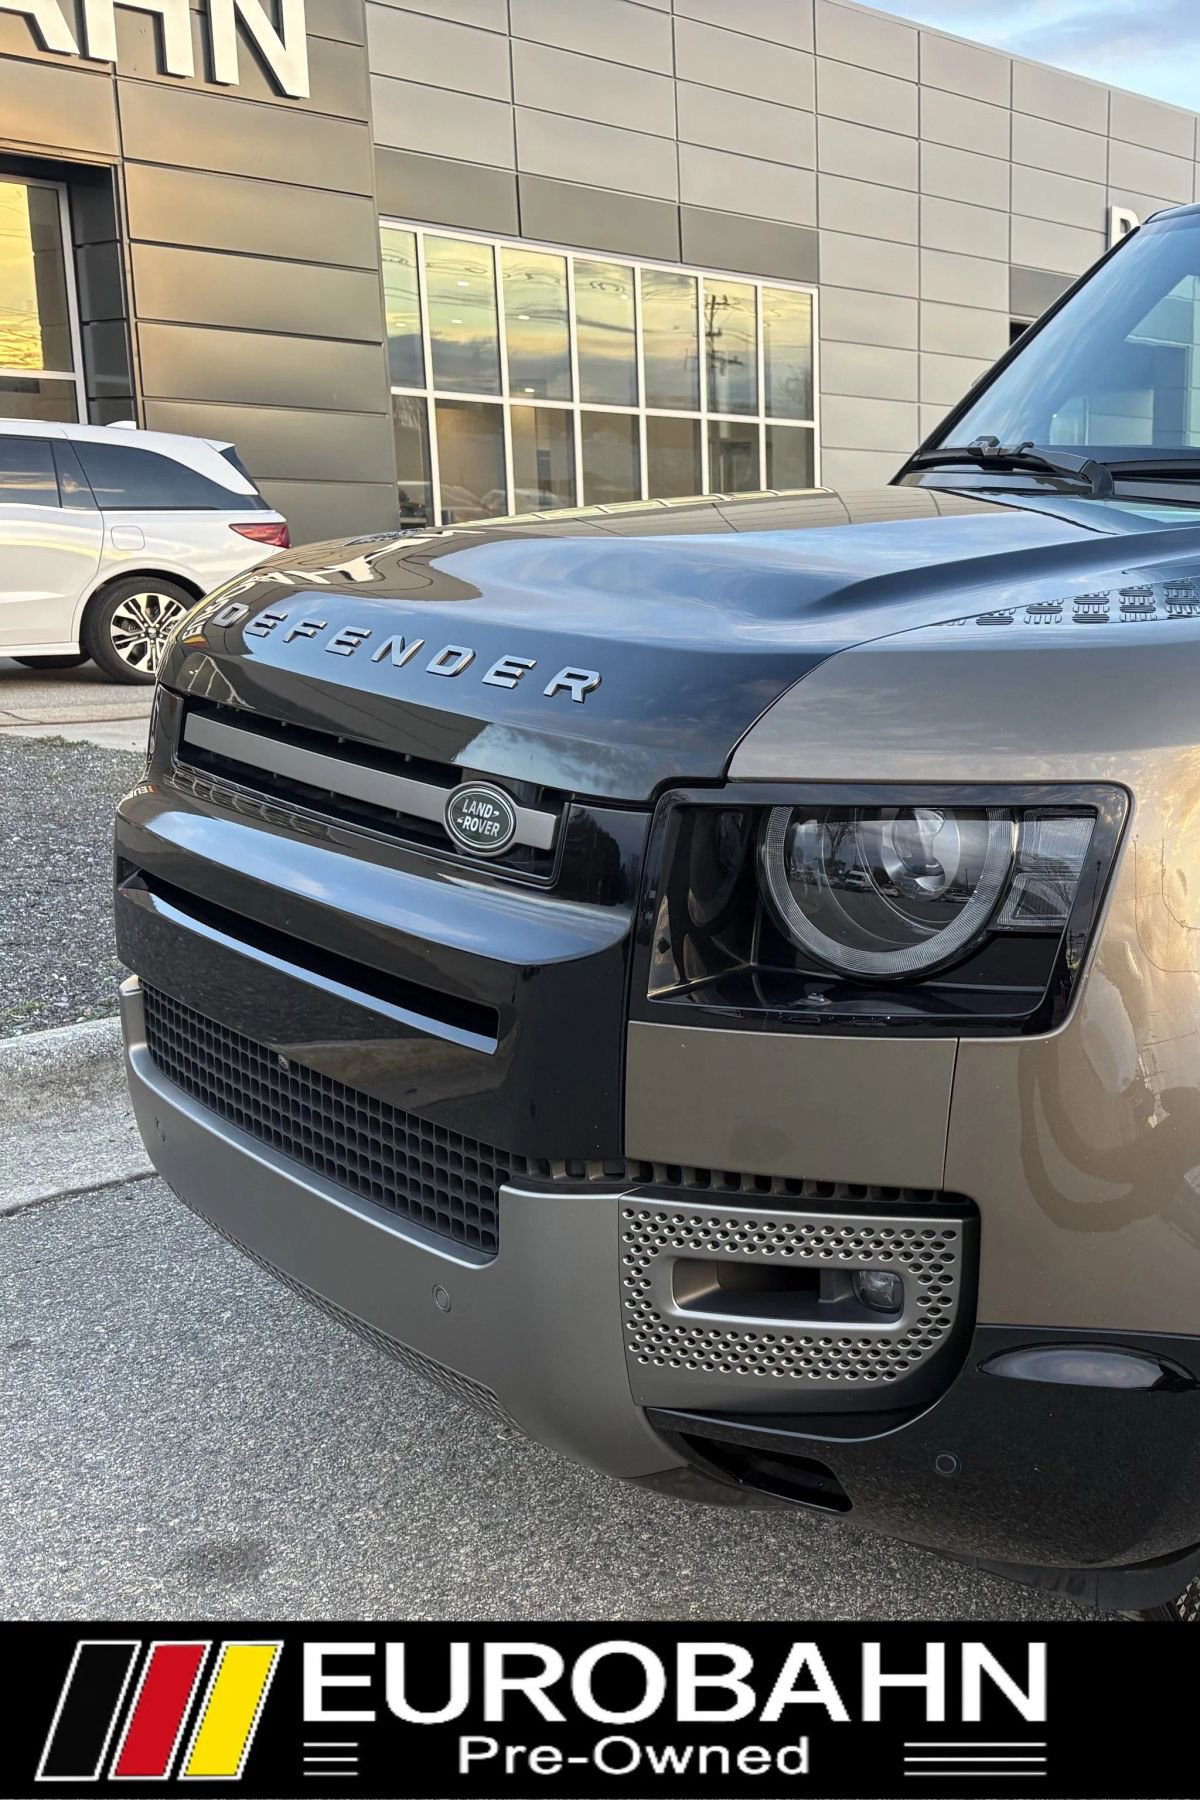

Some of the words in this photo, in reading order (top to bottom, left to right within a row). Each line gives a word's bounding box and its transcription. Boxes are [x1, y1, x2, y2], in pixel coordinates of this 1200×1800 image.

[212, 602, 602, 704] DEFENDER
[462, 798, 493, 818] LAND
[462, 815, 500, 837] ROVER
